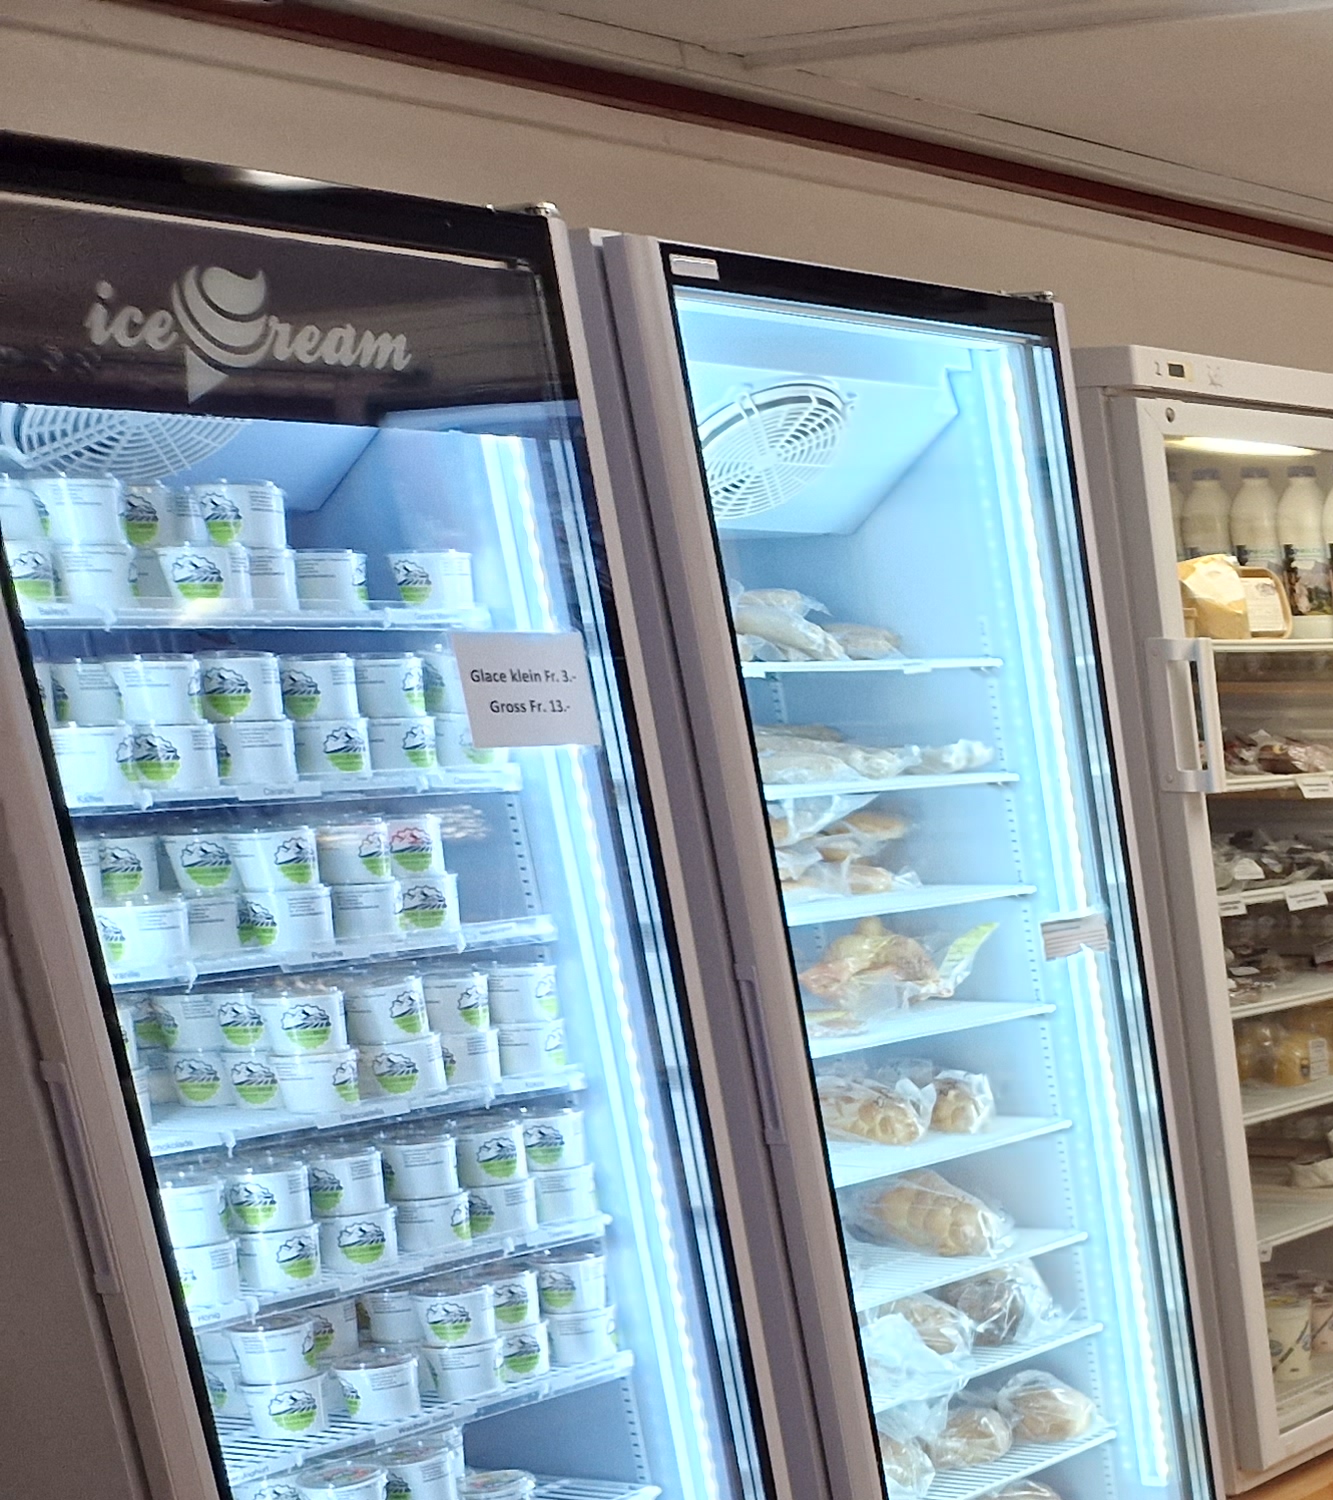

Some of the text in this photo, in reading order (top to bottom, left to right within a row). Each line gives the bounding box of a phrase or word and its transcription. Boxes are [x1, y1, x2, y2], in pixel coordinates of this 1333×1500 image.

[84, 280, 178, 351] ice
[470, 669, 577, 683] Glace klein Fr. 3.-
[490, 700, 571, 713] Gross Fr. 13.-
